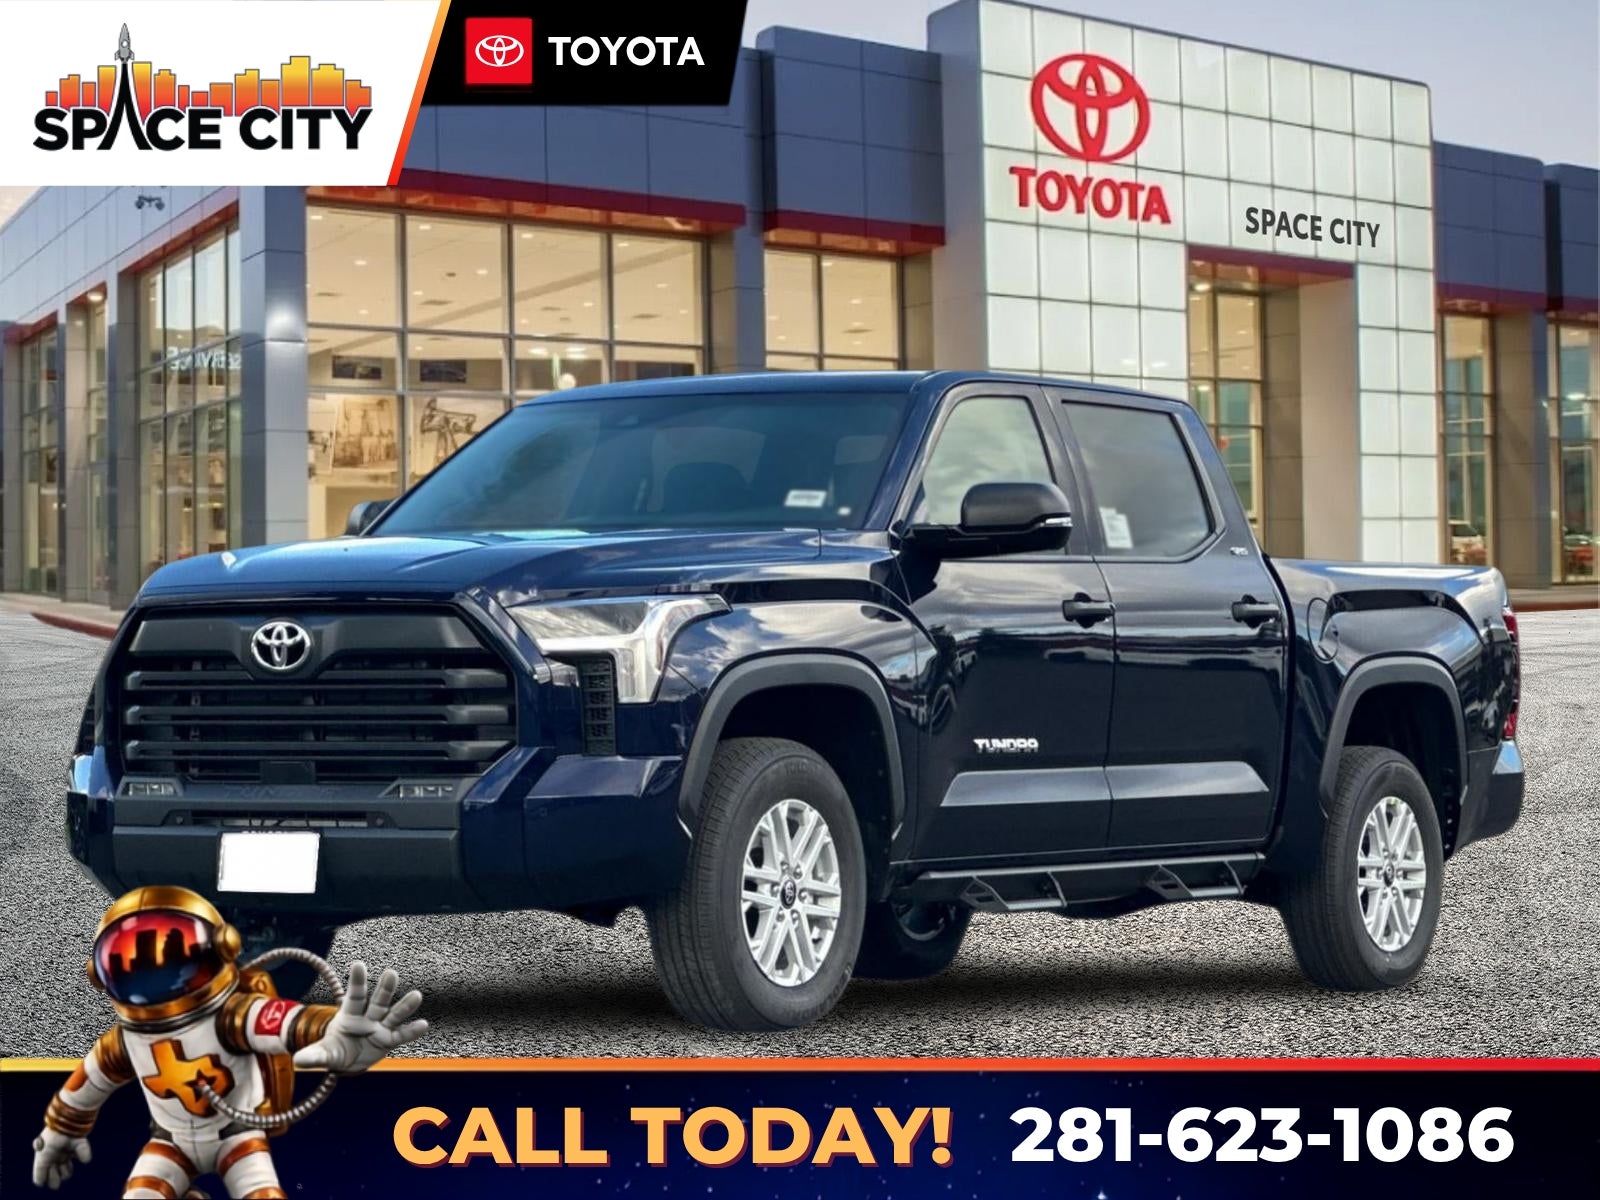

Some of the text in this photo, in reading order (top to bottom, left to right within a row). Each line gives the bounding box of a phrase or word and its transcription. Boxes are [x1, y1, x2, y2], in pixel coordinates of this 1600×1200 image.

[1008, 165, 1172, 225] TOYOTA
[1244, 206, 1381, 248] SPACE CITY
[973, 737, 1040, 754] TUNDRA
